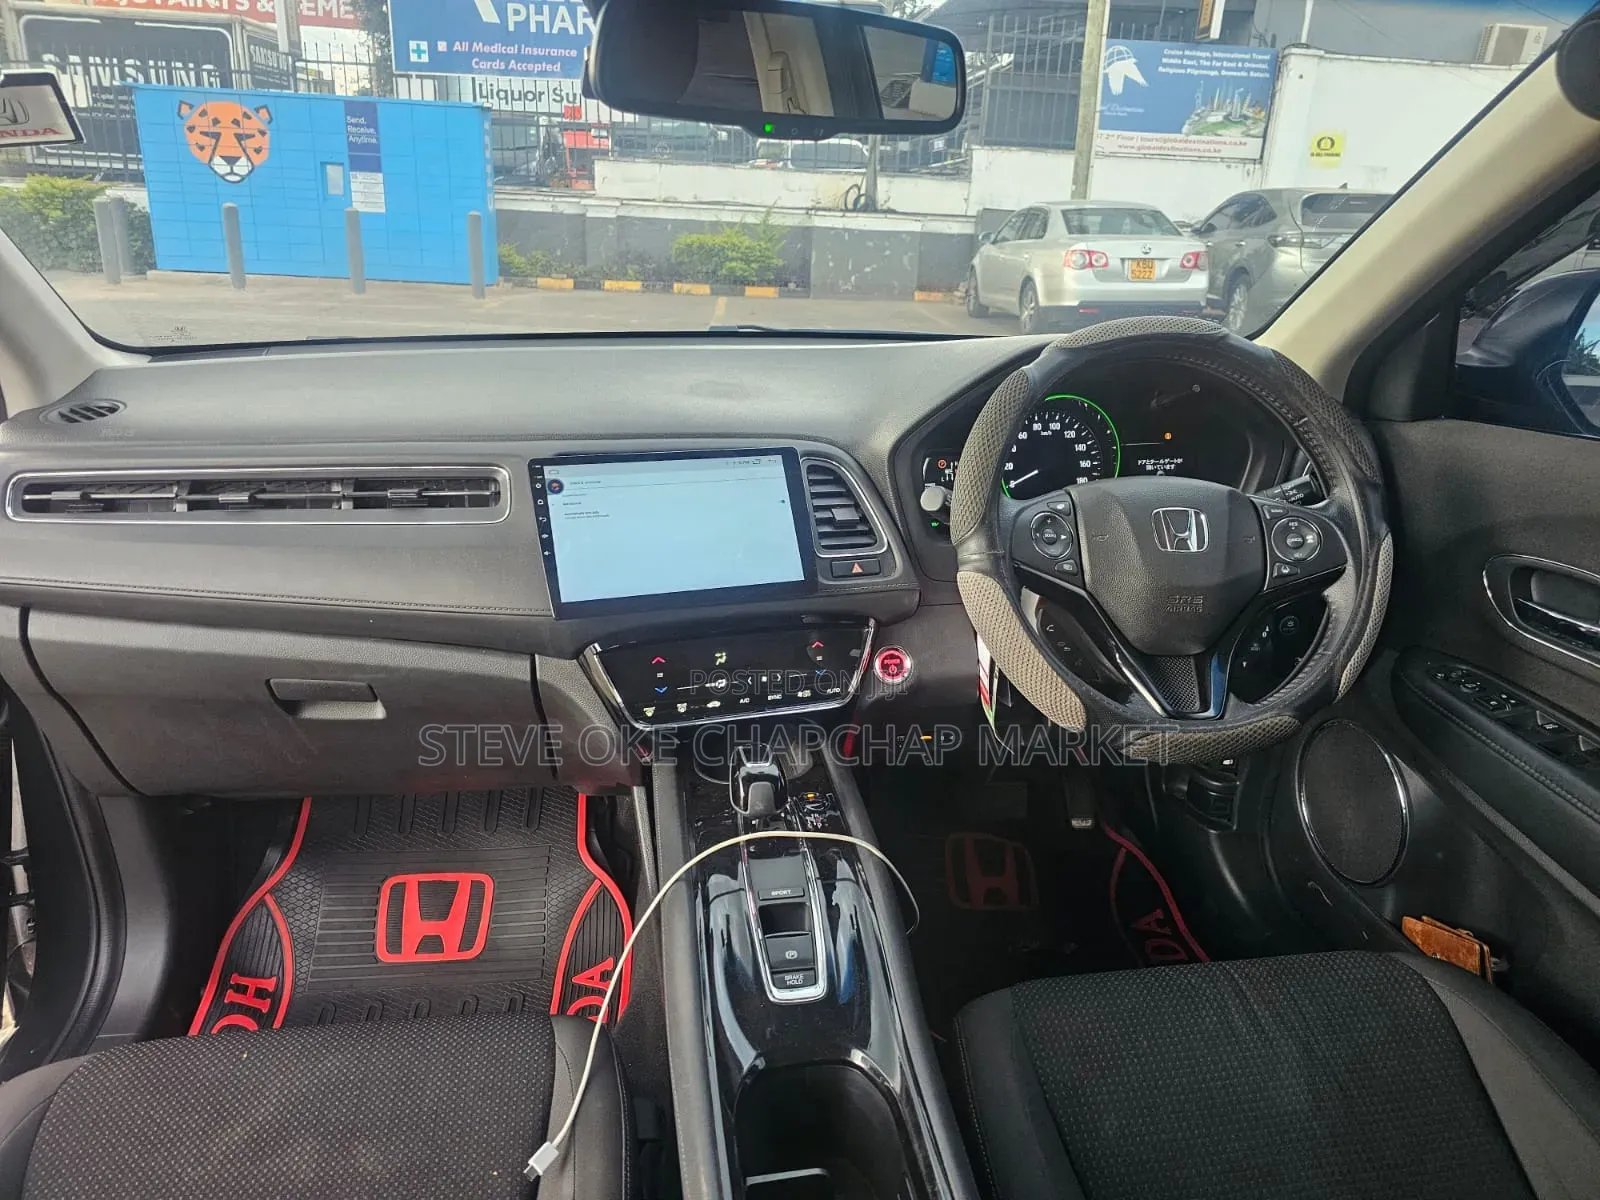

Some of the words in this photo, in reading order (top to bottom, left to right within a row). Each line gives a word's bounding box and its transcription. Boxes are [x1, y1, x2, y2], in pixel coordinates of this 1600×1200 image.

[453, 41, 468, 52] All
[472, 42, 518, 54] Medical
[521, 44, 578, 57] Insurance
[472, 58, 505, 70] Cards
[508, 60, 561, 73] Accepted
[479, 83, 545, 105] Liquor
[346, 115, 367, 124] Send.
[347, 125, 377, 135] Receive.
[1049, 422, 1061, 430] 100
[1018, 431, 1028, 440] 60
[1064, 430, 1076, 439] 120
[1075, 443, 1087, 451] 140
[1004, 462, 1014, 470] 20
[1080, 460, 1091, 468] 160
